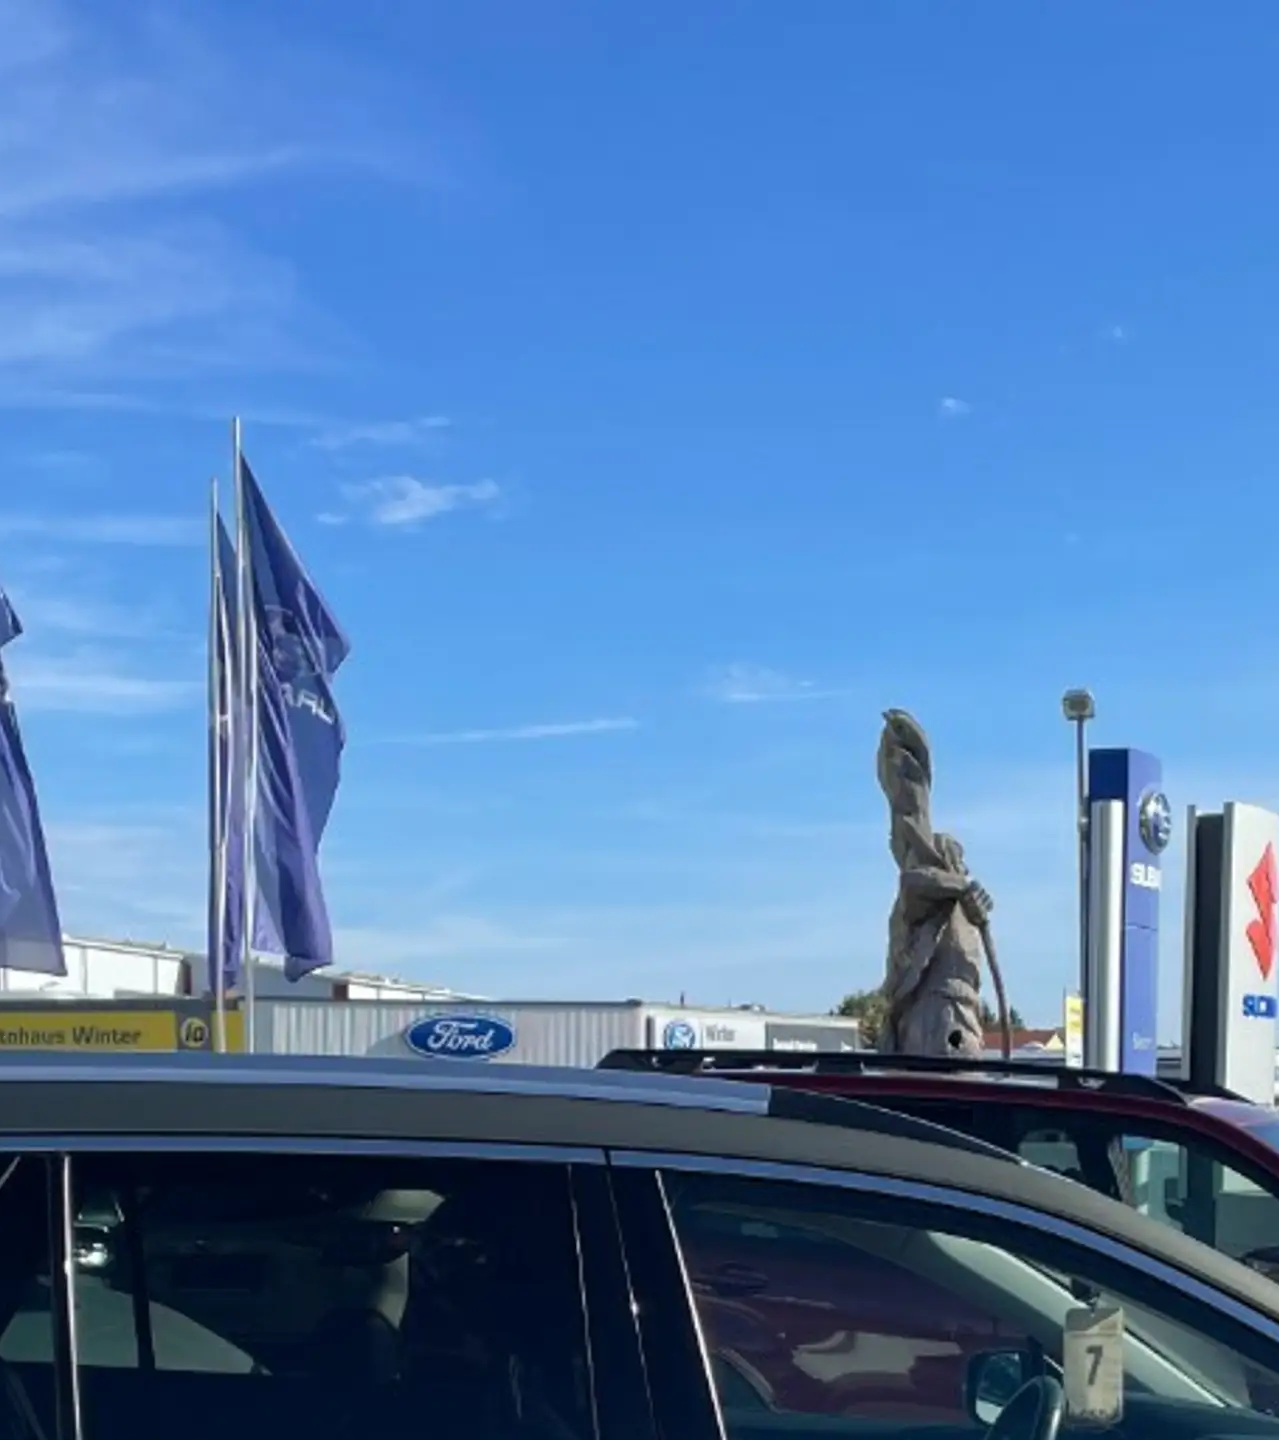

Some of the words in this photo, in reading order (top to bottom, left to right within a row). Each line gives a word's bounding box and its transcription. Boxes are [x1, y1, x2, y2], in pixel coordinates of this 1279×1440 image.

[71, 1024, 142, 1045] Winter
[426, 1020, 497, 1050] Ford
[1085, 1344, 1104, 1386] 7
